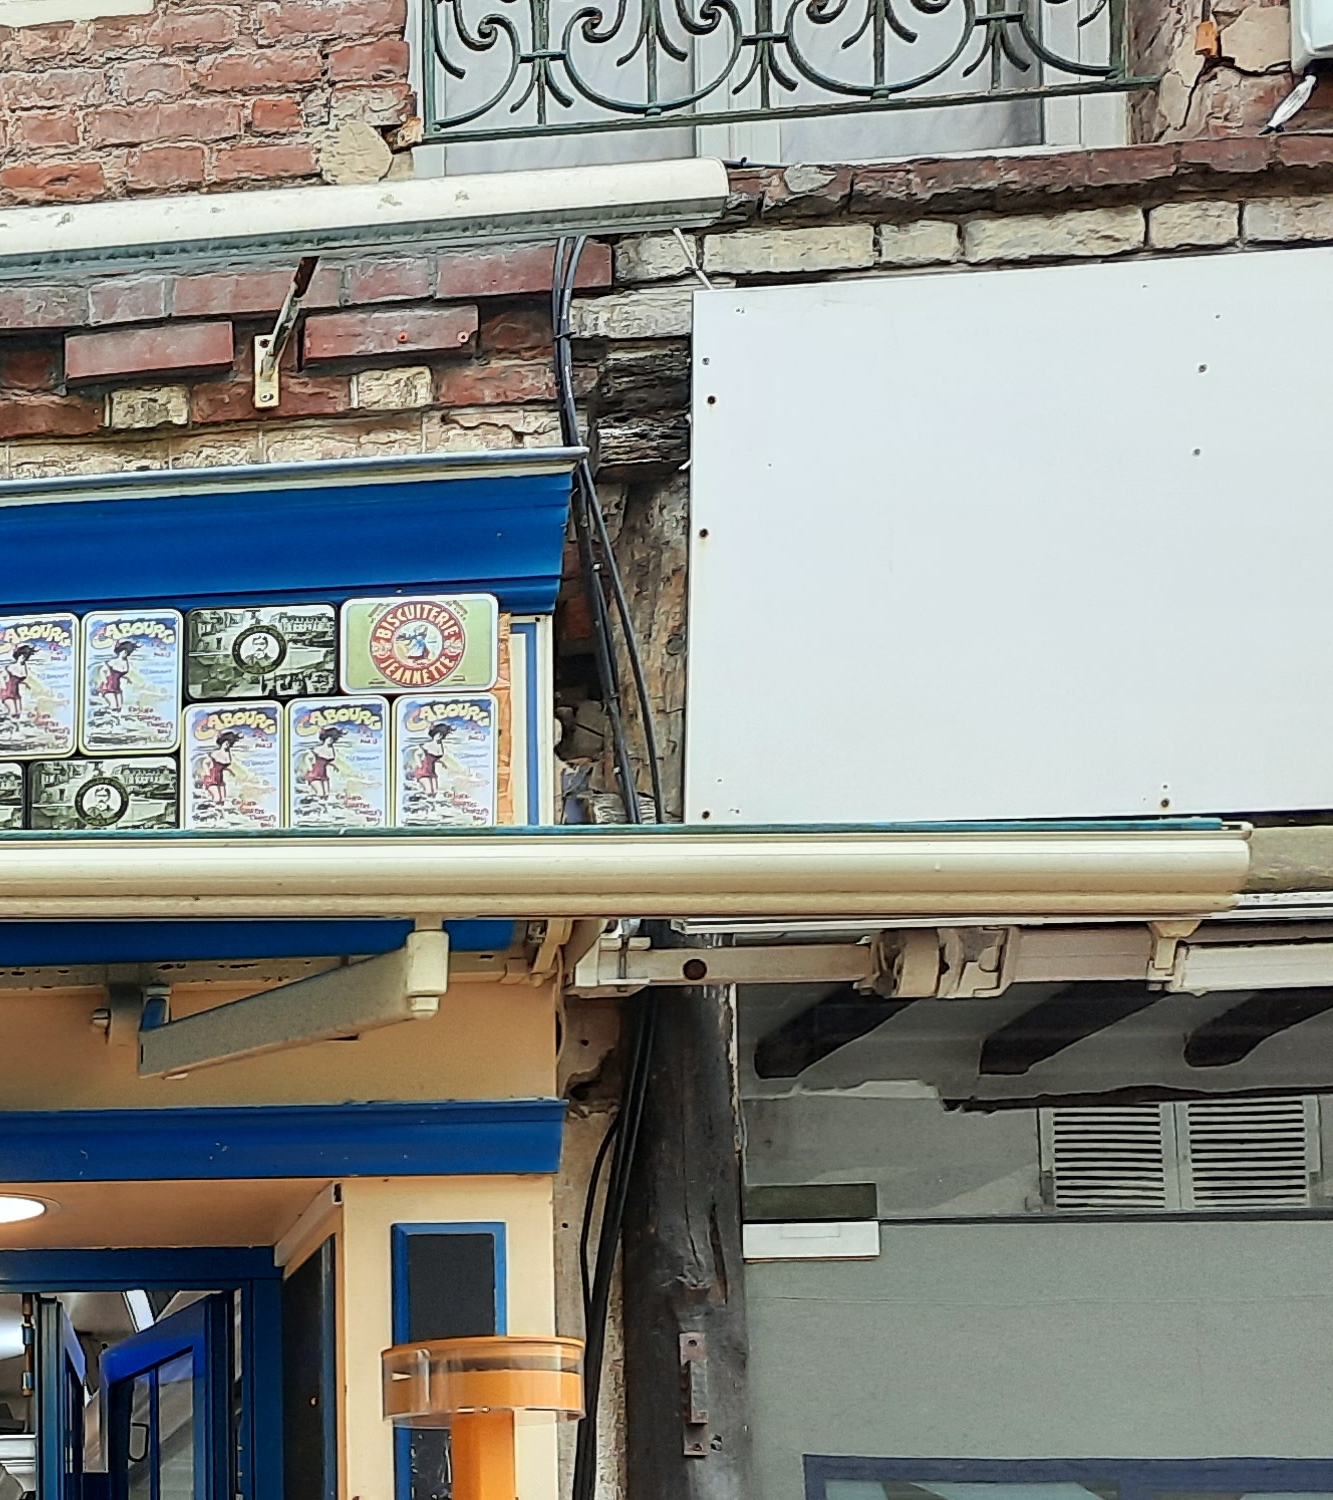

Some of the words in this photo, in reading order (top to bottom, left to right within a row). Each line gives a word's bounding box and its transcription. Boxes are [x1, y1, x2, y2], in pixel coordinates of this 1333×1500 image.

[92, 619, 175, 649] CABOURG
[376, 603, 459, 641] BISCUITERIE
[379, 655, 457, 685] JEANNETTE
[193, 709, 276, 740] CABOURG
[297, 706, 382, 737] CABOURG
[405, 701, 489, 734] CABOURG
